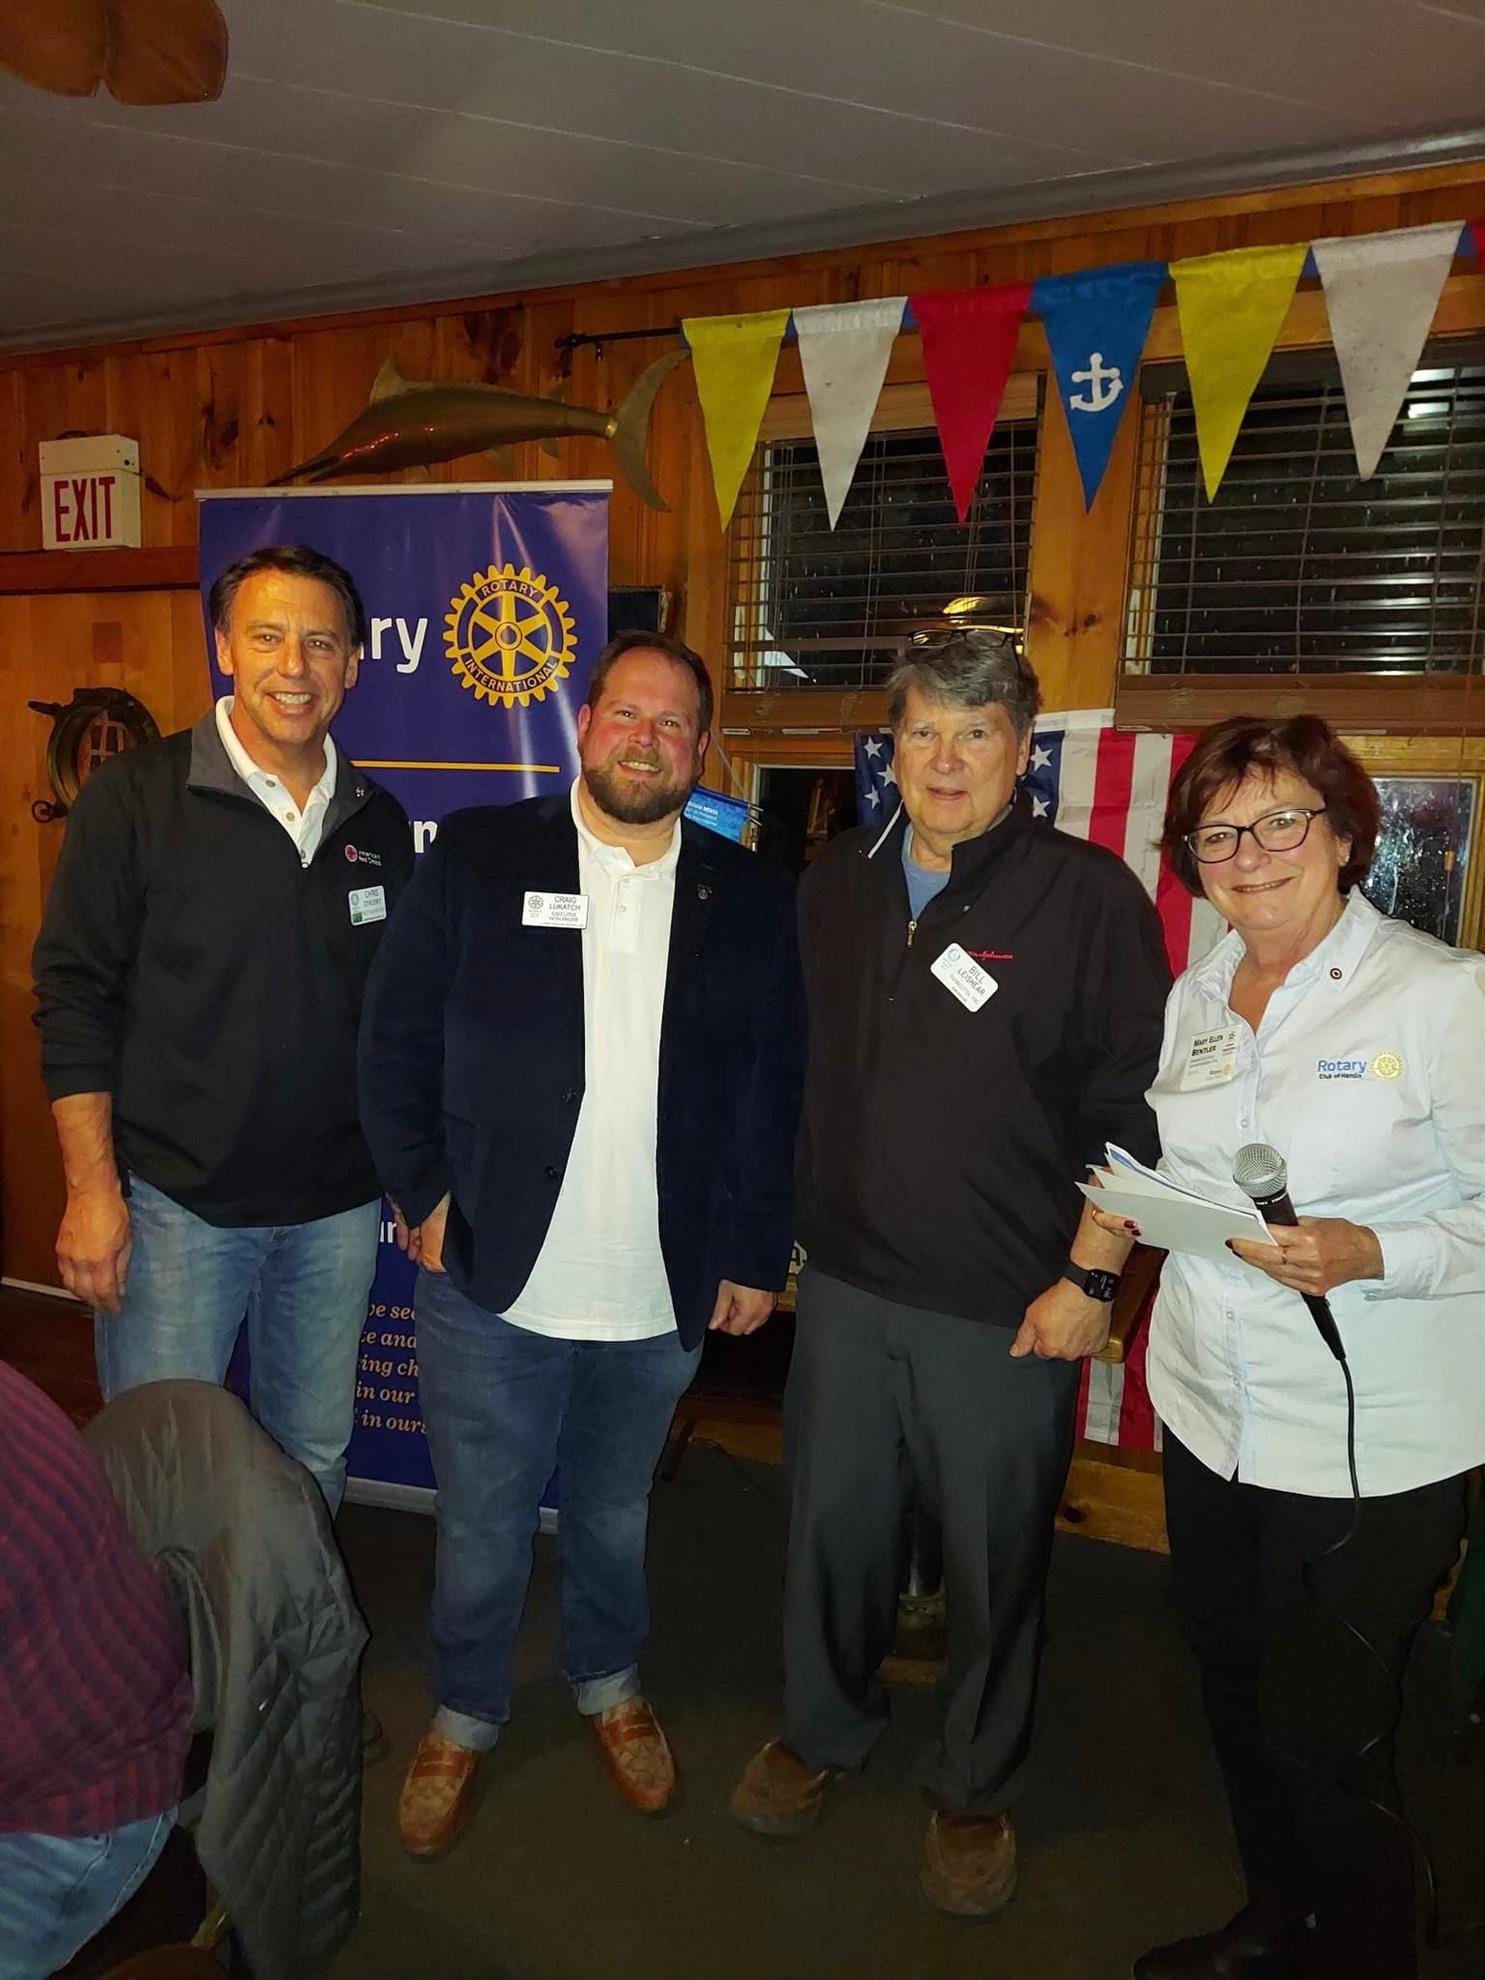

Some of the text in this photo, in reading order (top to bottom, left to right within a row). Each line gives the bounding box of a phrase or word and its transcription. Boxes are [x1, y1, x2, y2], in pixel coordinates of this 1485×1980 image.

[54, 476, 116, 542] EXIT
[482, 579, 540, 598] ROTARY
[464, 659, 558, 692] INTERNATIONAL
[548, 903, 581, 912] LUKATCH
[553, 895, 577, 904] CRAIG
[968, 965, 986, 985] BILL
[1317, 1059, 1367, 1074] Rotary
[356, 1381, 416, 1405] in our
[361, 1409, 382, 1429] in
